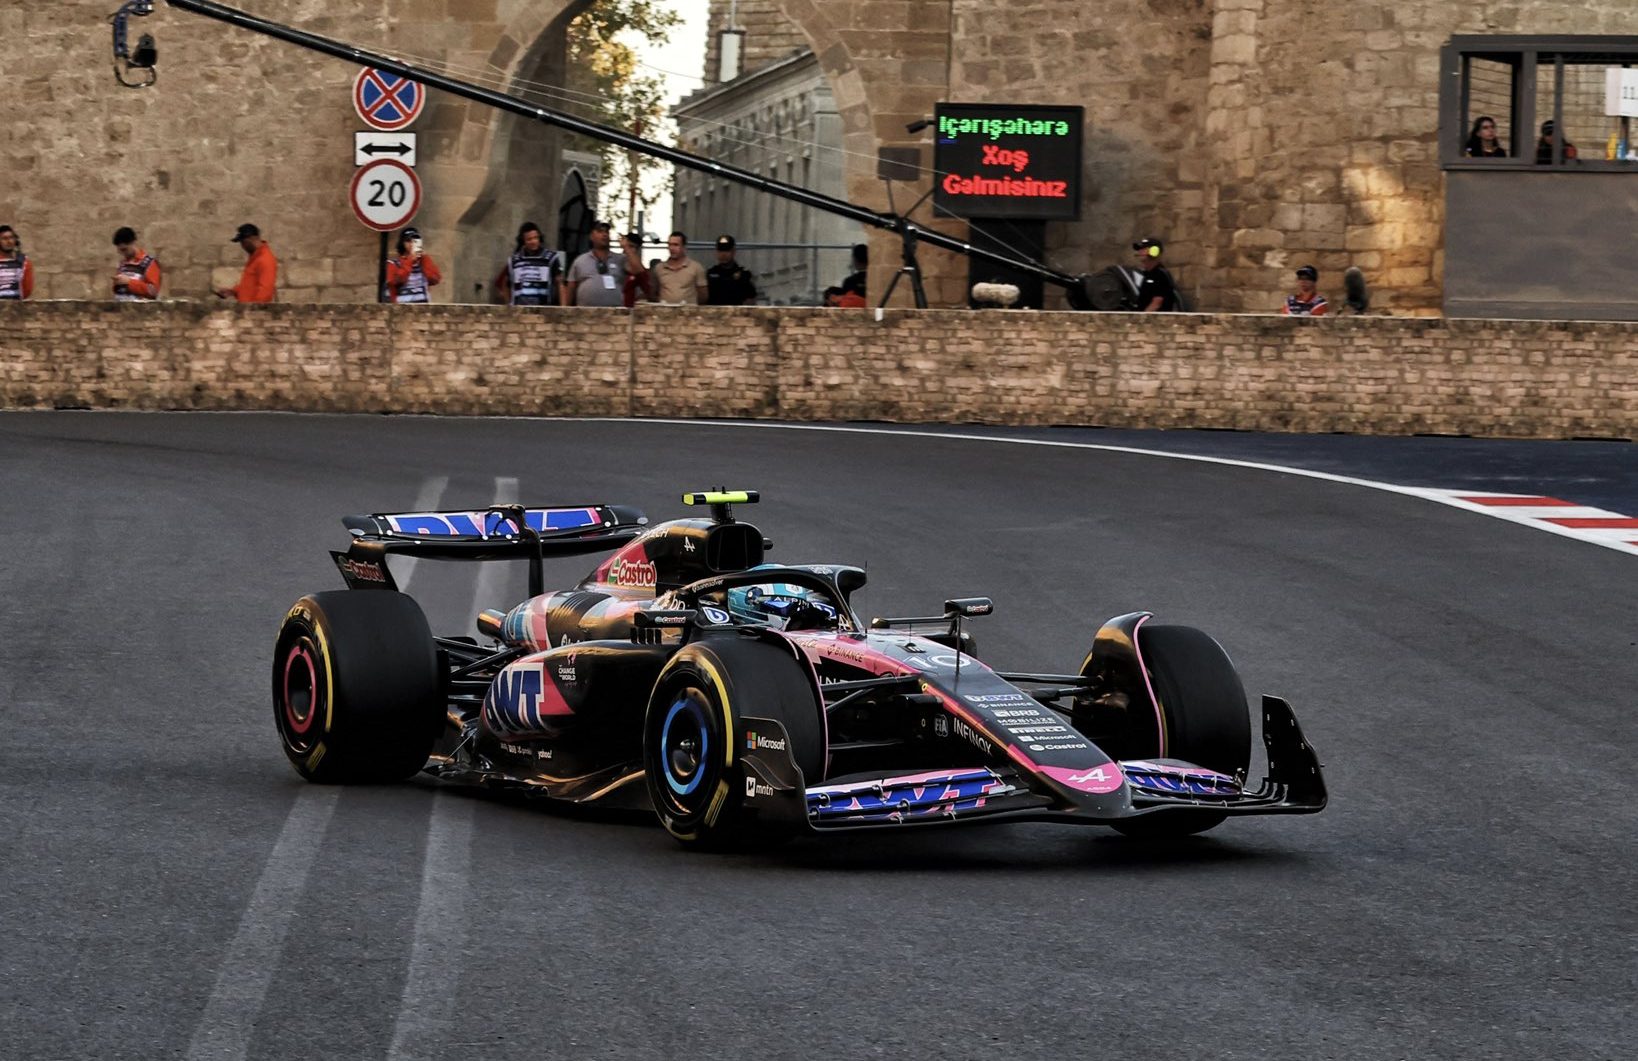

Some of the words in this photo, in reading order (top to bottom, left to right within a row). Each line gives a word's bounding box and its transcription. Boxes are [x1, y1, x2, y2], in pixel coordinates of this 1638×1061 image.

[982, 145, 1029, 172] Xoş
[367, 180, 406, 207] 20
[618, 559, 658, 587] Castrol
[902, 655, 972, 669] 10
[1008, 709, 1041, 717] BRB
[757, 735, 786, 751] Microsoft
[953, 716, 993, 757] INFINOX
[1033, 734, 1078, 742] Microsoft
[1044, 743, 1089, 751] Castrol
[755, 784, 774, 797] mntn
